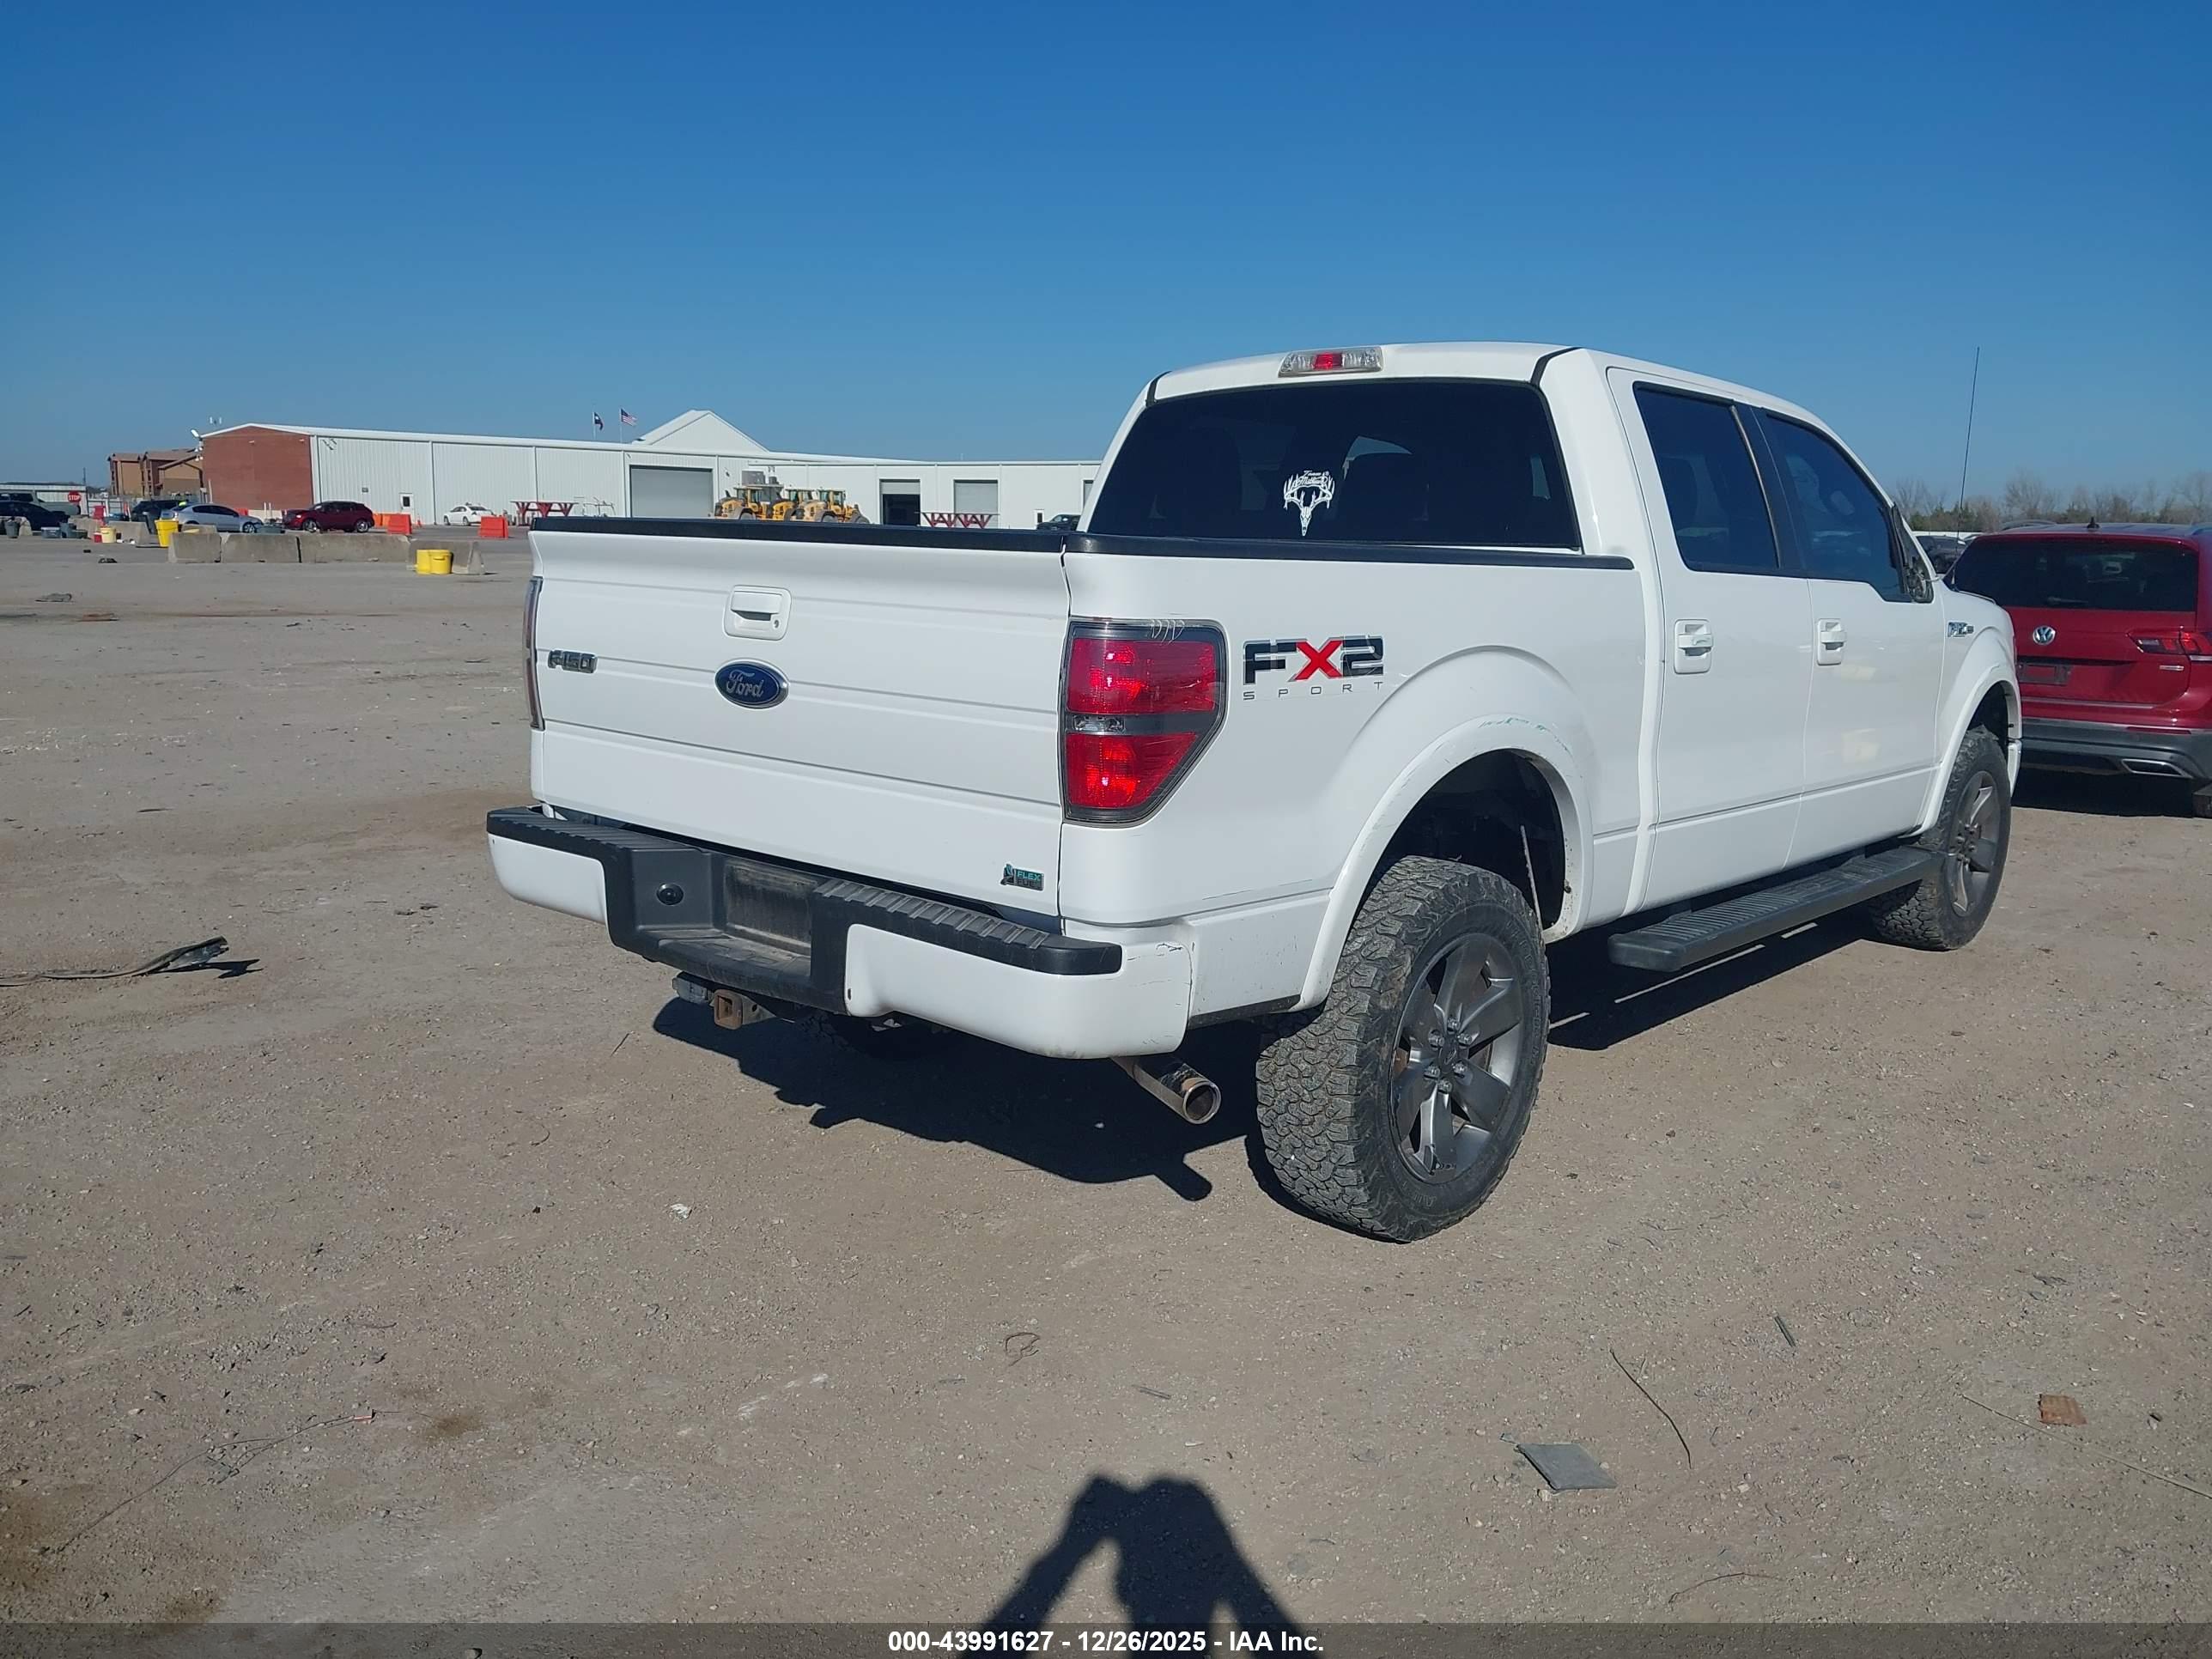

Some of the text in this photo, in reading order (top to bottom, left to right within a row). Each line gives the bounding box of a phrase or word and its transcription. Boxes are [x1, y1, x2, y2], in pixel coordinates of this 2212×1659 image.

[1243, 635, 1384, 685] FX2
[726, 670, 764, 698] Ford
[1243, 682, 1384, 701] SPORT
[1017, 870, 1041, 881] FLEX
